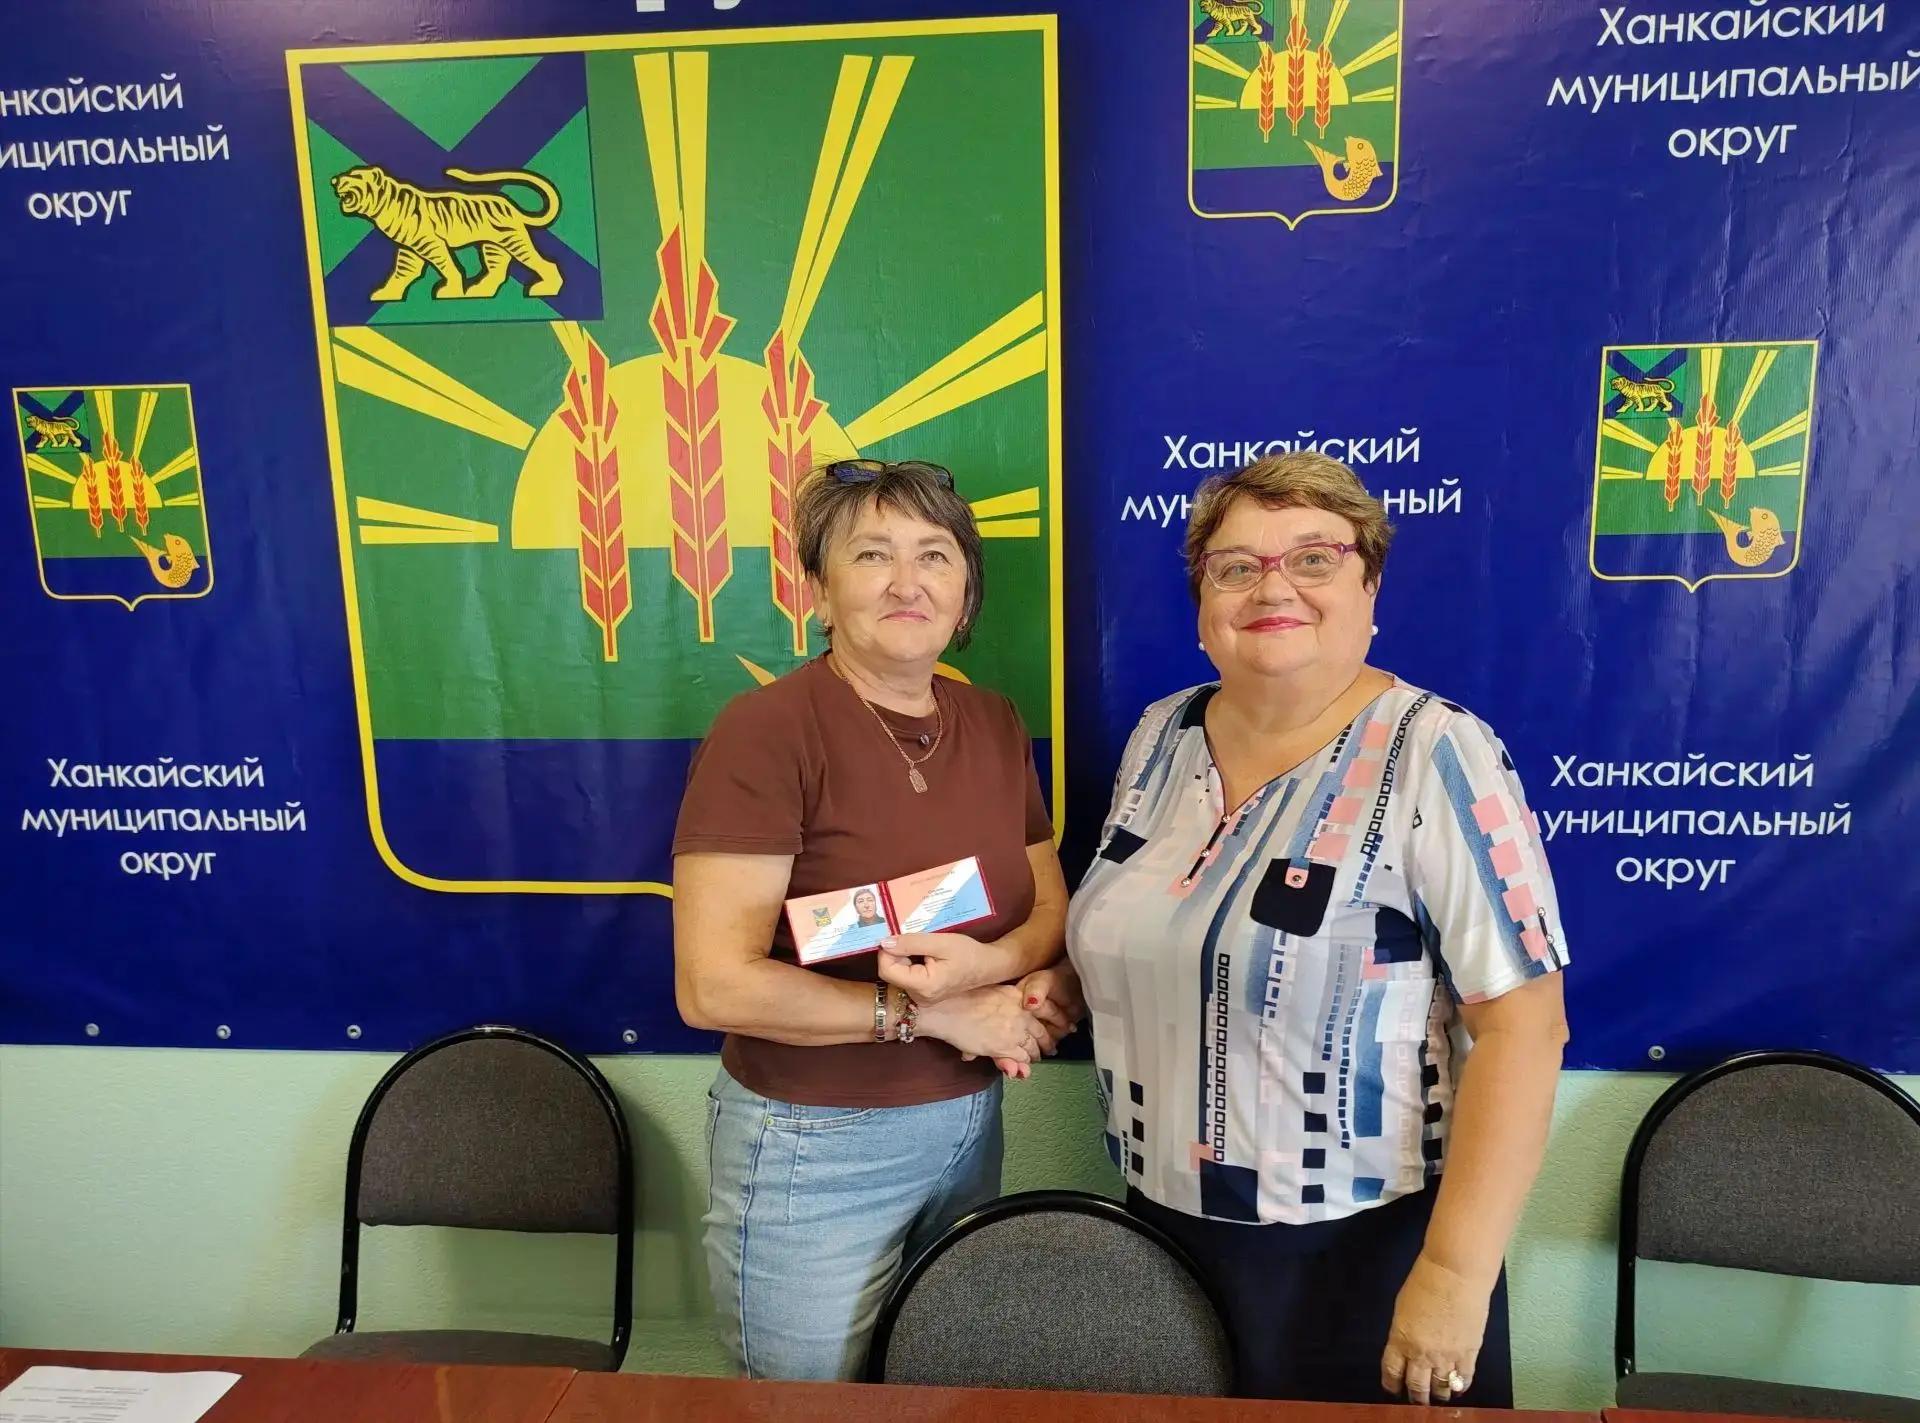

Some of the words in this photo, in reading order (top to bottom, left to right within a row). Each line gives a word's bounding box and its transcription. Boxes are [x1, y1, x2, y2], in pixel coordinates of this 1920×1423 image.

[1597, 0, 1885, 46] Ханкайский
[0, 73, 183, 117] нкайский
[1546, 50, 1920, 113] муниципальный
[0, 124, 229, 171] иципальный
[1668, 124, 1797, 165] округ
[28, 189, 132, 226] округ
[47, 757, 265, 787] Ханкайский
[1550, 753, 1814, 787] Ханкайский
[22, 801, 307, 838] муниципальный
[1531, 802, 1851, 841] униципальный
[120, 852, 217, 881] округ
[1615, 857, 1736, 891] округ
